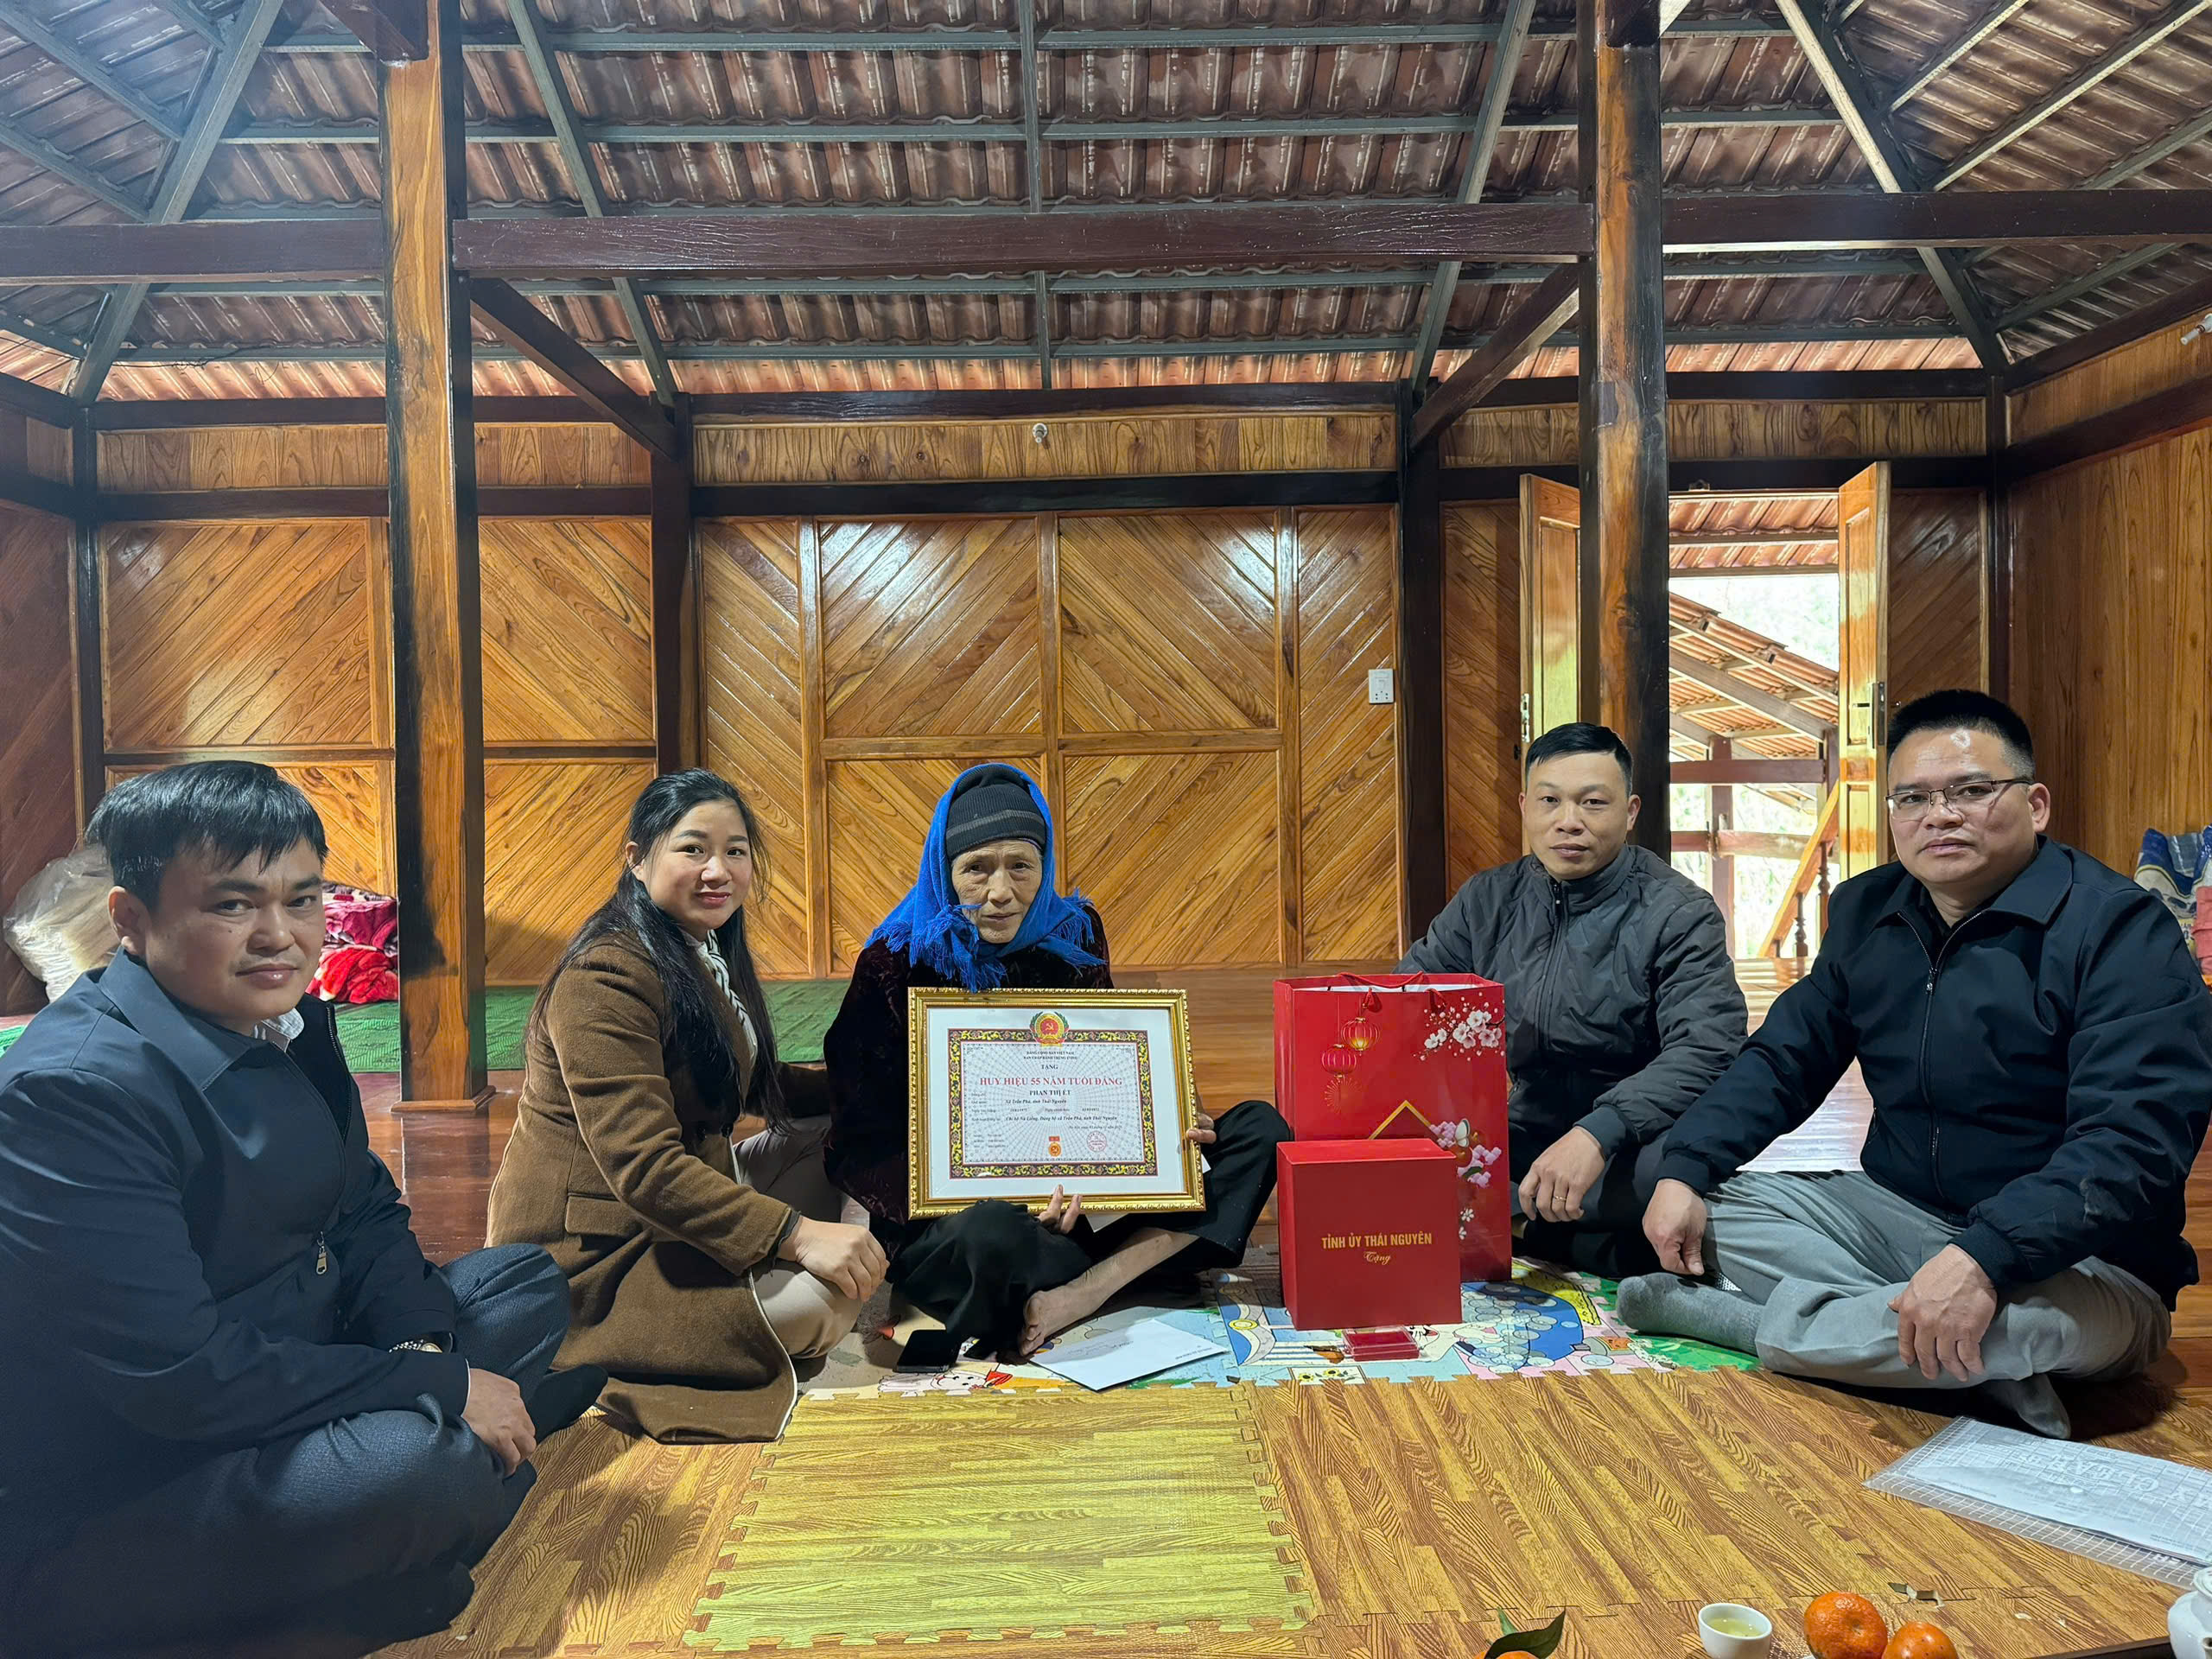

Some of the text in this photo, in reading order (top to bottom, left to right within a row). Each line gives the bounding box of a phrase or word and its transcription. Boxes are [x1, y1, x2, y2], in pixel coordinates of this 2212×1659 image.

[1004, 1077, 1028, 1087] HIỆU
[1043, 1075, 1065, 1085] NĂM
[1068, 1075, 1093, 1085] TUỔI
[1095, 1075, 1122, 1085] ĐẢNG
[1321, 1230, 1433, 1249] TỈNH ỦY THÁI NGUYÊN
